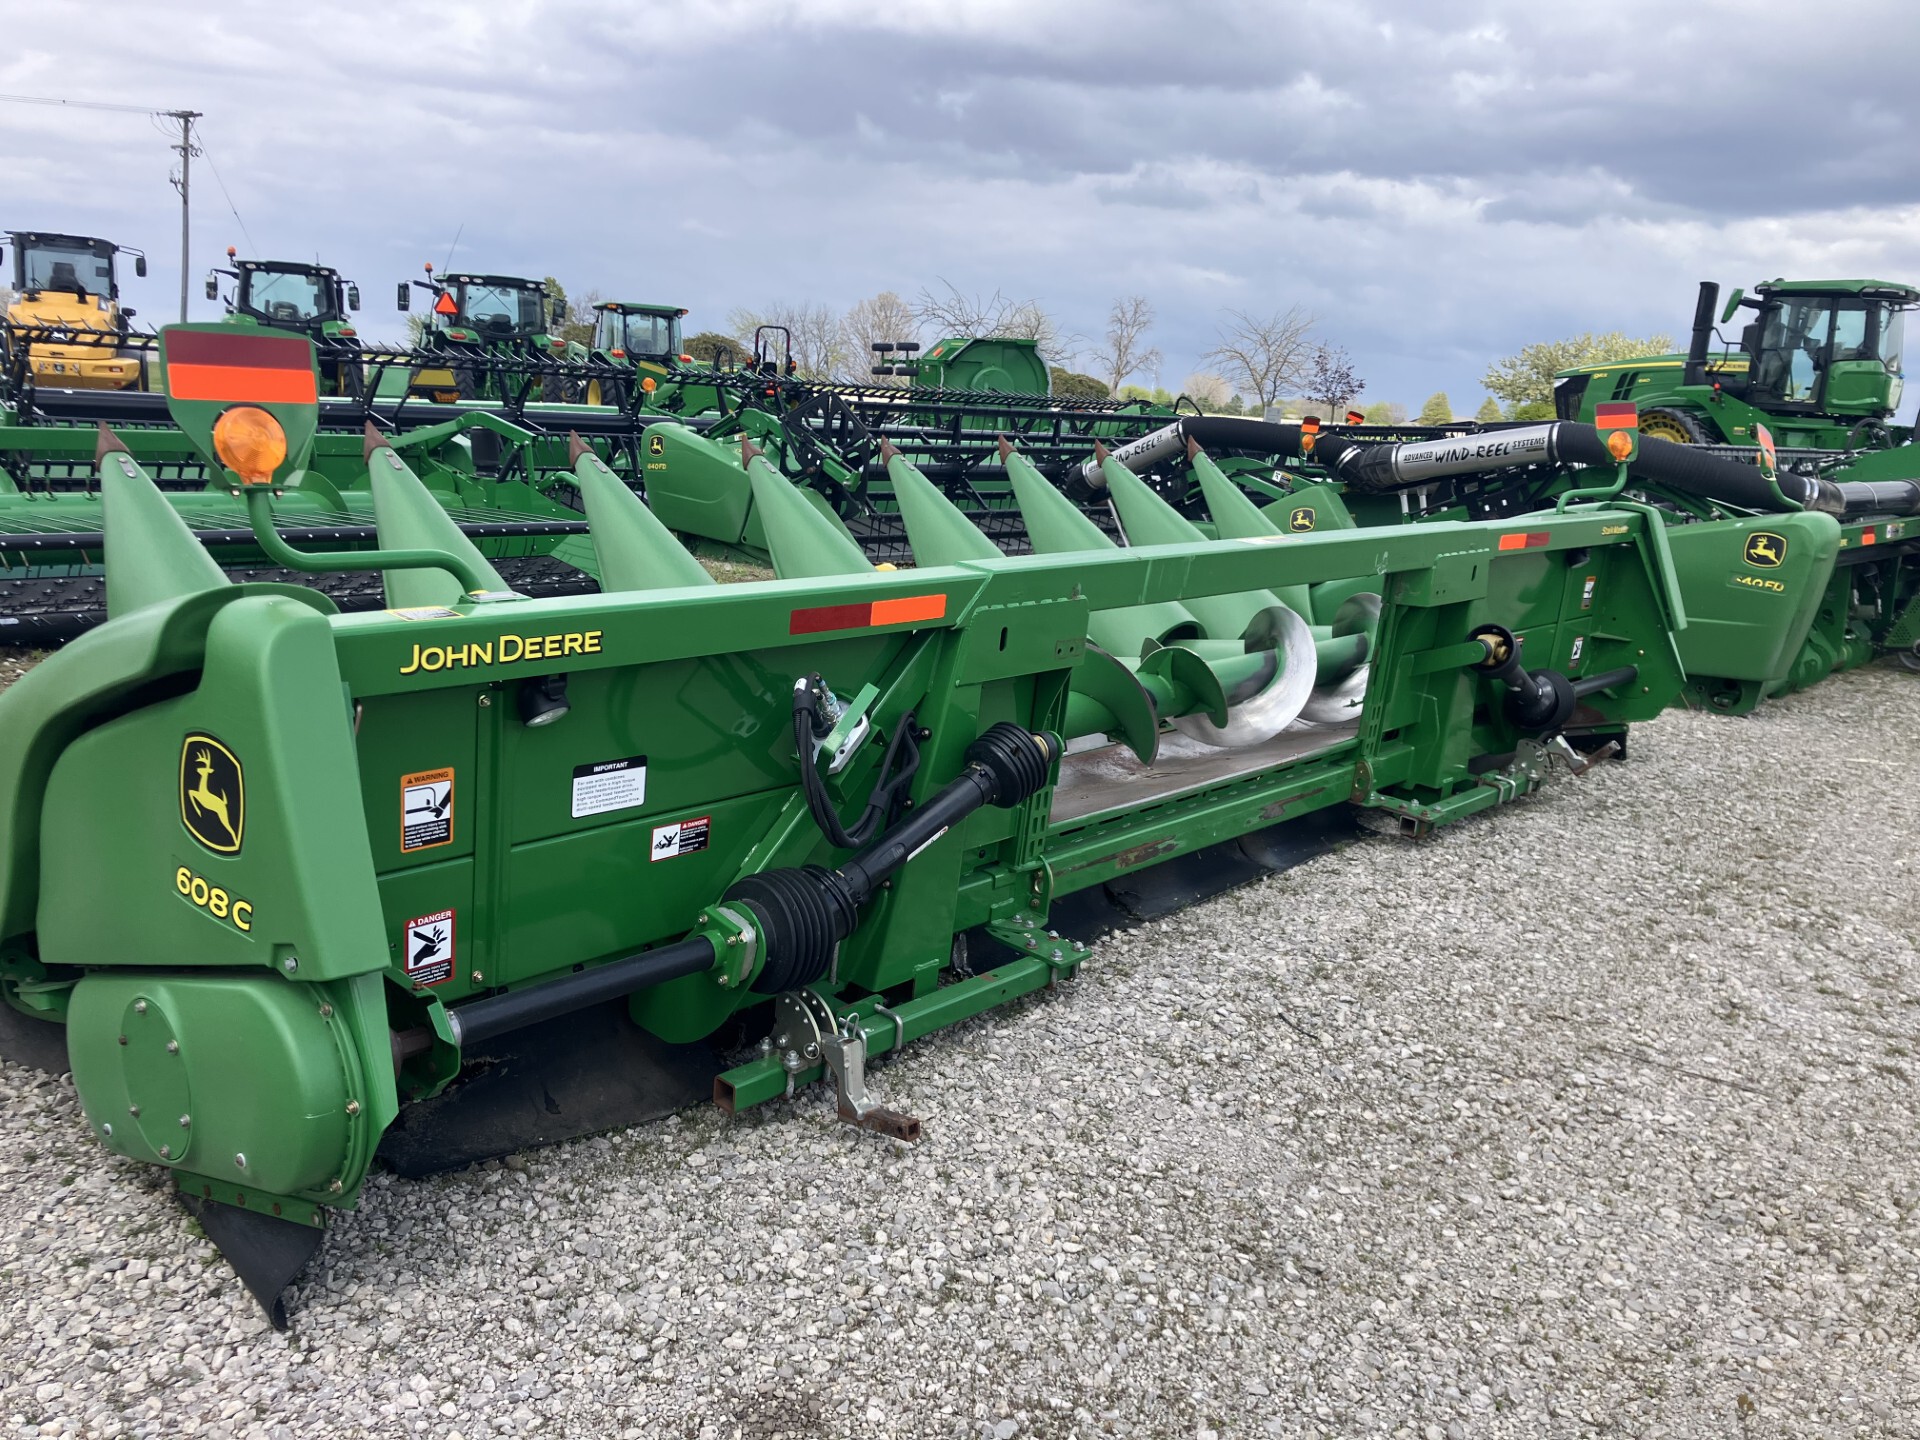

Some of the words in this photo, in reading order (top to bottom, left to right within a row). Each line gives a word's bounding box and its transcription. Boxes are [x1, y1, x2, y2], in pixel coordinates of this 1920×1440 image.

[1403, 451, 1433, 462] ADVANCED
[1435, 442, 1510, 464] WIND-REEL
[1512, 437, 1546, 449] SYSTEMS
[399, 641, 494, 674] JOHN
[499, 629, 603, 663] DEERE
[414, 771, 449, 783] WARNING
[594, 761, 629, 772] IMPORTANT
[176, 865, 253, 932] 608C
[417, 910, 452, 926] DANGER
